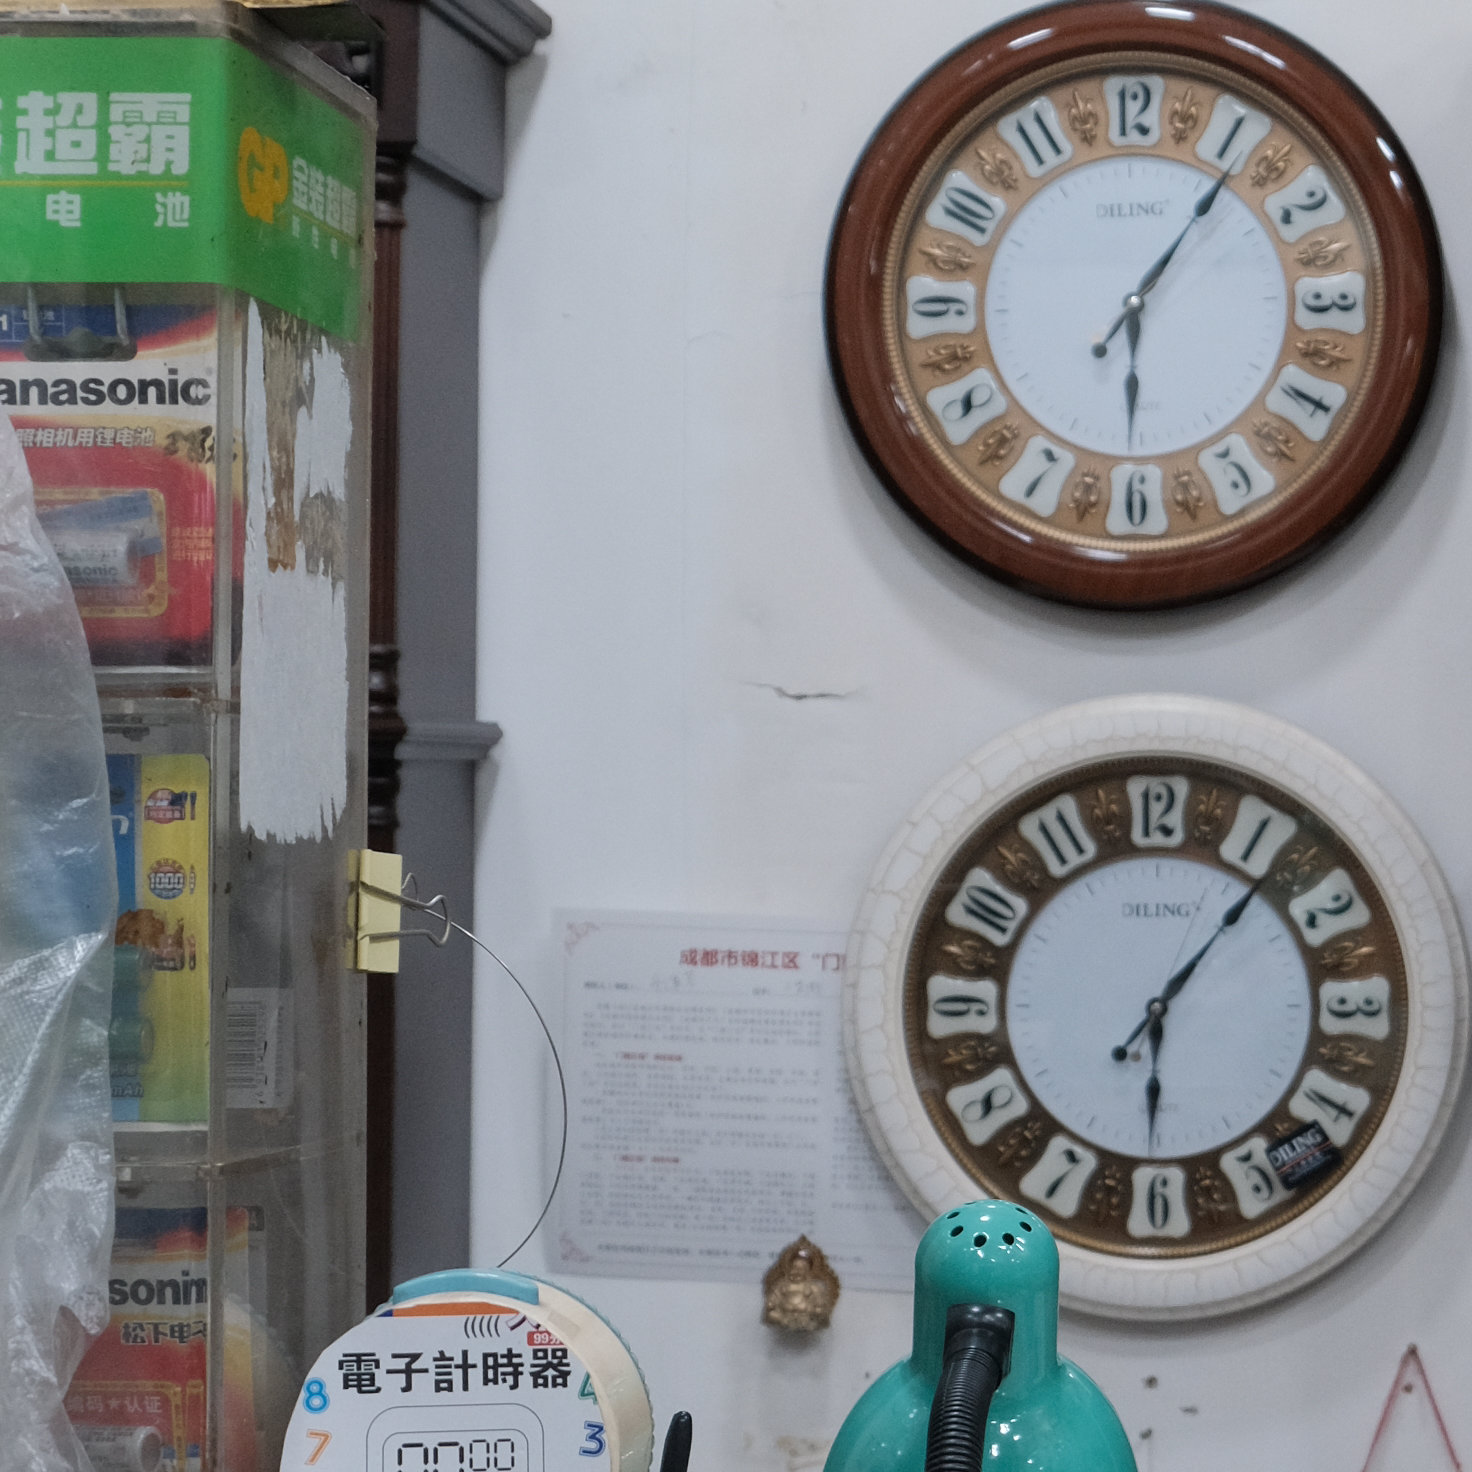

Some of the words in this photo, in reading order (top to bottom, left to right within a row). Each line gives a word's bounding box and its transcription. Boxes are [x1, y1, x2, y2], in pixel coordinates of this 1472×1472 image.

[1118, 80, 1152, 138] 12
[15, 90, 193, 177] 超霸
[1016, 112, 1063, 168] 11
[1217, 113, 1247, 162] 1
[45, 192, 191, 228] 电池
[941, 185, 997, 235] 10
[1280, 187, 1329, 227] 2
[1302, 290, 1358, 314] 3
[942, 385, 995, 422] 8
[1280, 381, 1333, 419] 4
[16, 427, 157, 449] 照相机用锂电池
[1023, 446, 1060, 499] 7
[1214, 445, 1253, 498] 5
[1124, 472, 1149, 528] 6
[1140, 781, 1178, 840] 12
[1038, 805, 1088, 867] 11
[1240, 814, 1273, 865] 1
[962, 884, 1019, 934] 10
[1305, 890, 1356, 929] 2
[679, 947, 801, 971] 成都市锦江区
[1327, 995, 1382, 1020] 3
[961, 1085, 1015, 1121] 8
[1302, 1085, 1357, 1122] 4
[1045, 1148, 1083, 1201] 7
[1236, 1151, 1276, 1204] 5
[1147, 1174, 1170, 1230] 6
[338, 1347, 572, 1395] 電子計時器
[303, 1377, 331, 1414] 8
[305, 1430, 332, 1466] 7
[579, 1420, 606, 1458] 3
